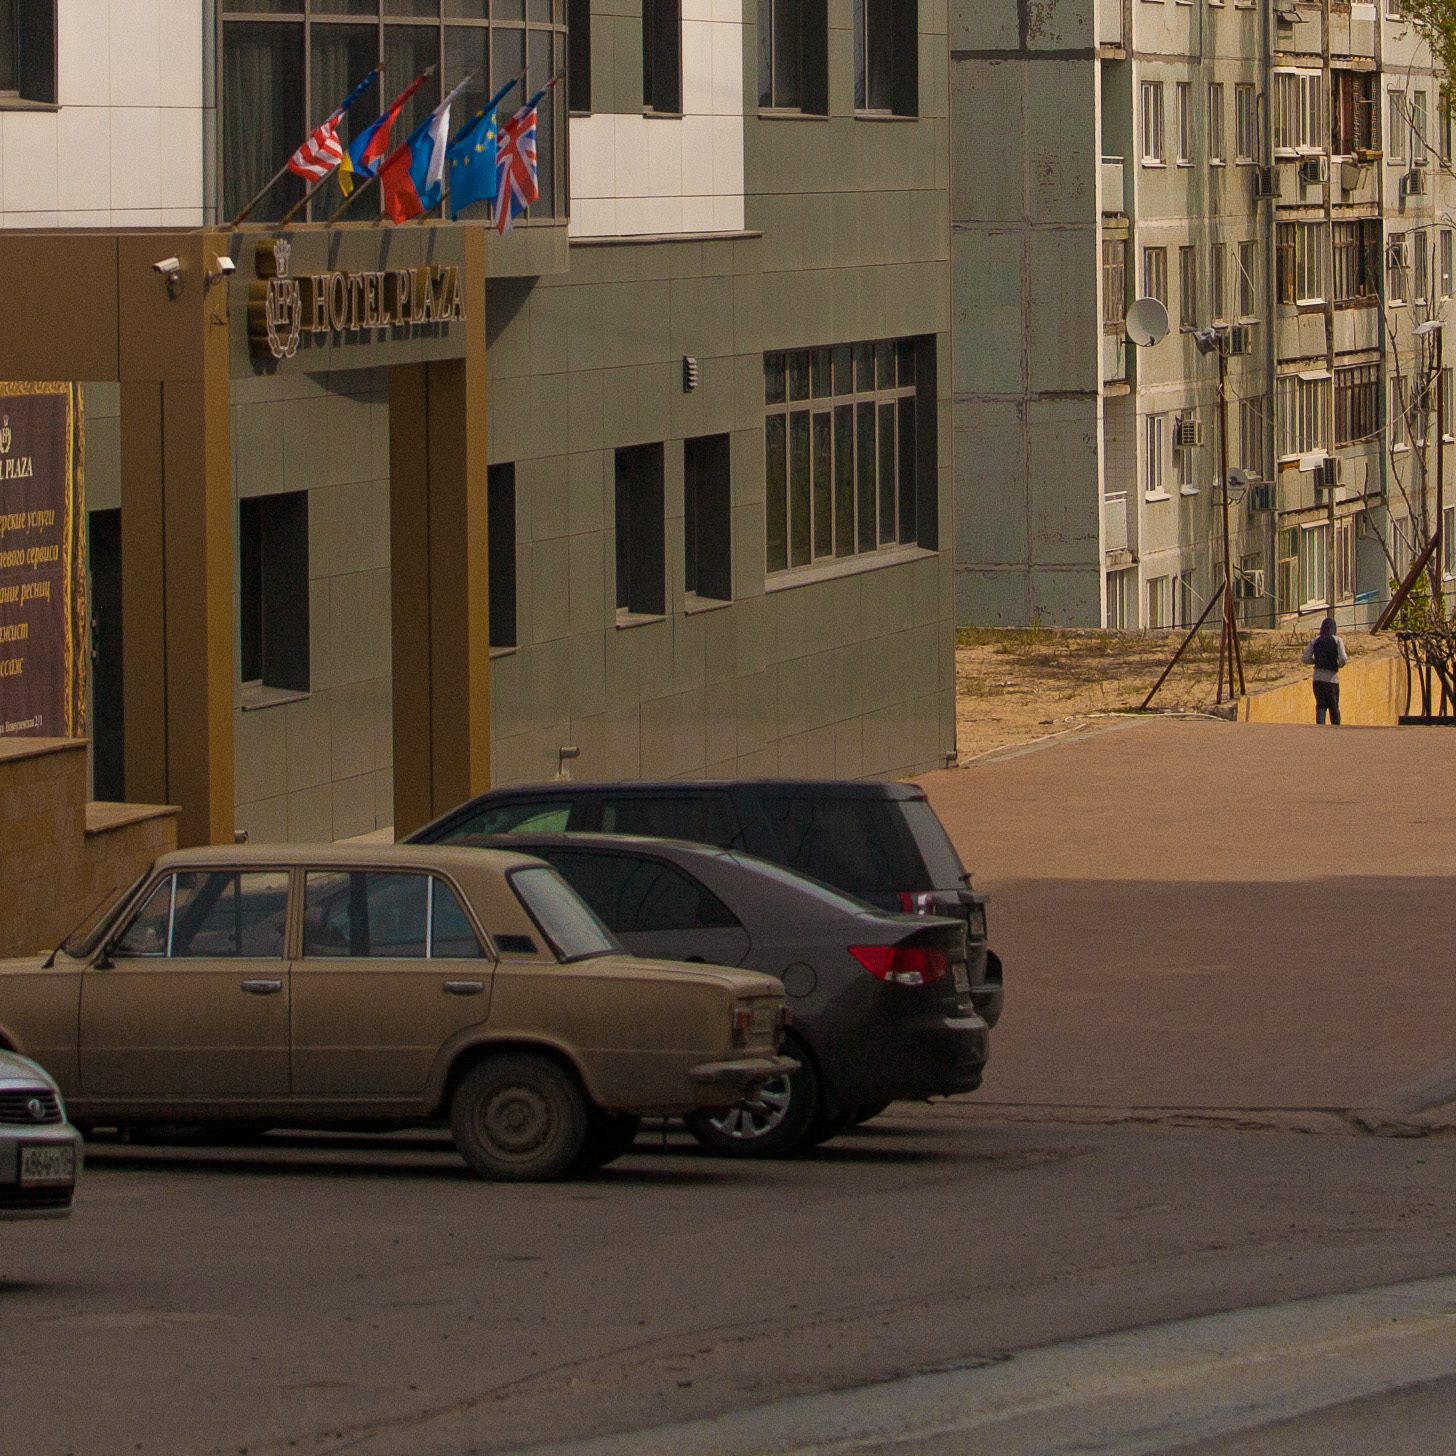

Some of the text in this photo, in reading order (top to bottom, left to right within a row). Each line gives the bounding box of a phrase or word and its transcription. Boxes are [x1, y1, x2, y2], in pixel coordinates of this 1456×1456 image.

[311, 265, 466, 332] HOTEL PLAZA
[5, 457, 33, 480] PLAZA
[26, 509, 55, 535] услуги
[26, 544, 59, 570] сервиса
[20, 581, 51, 607] ресниц
